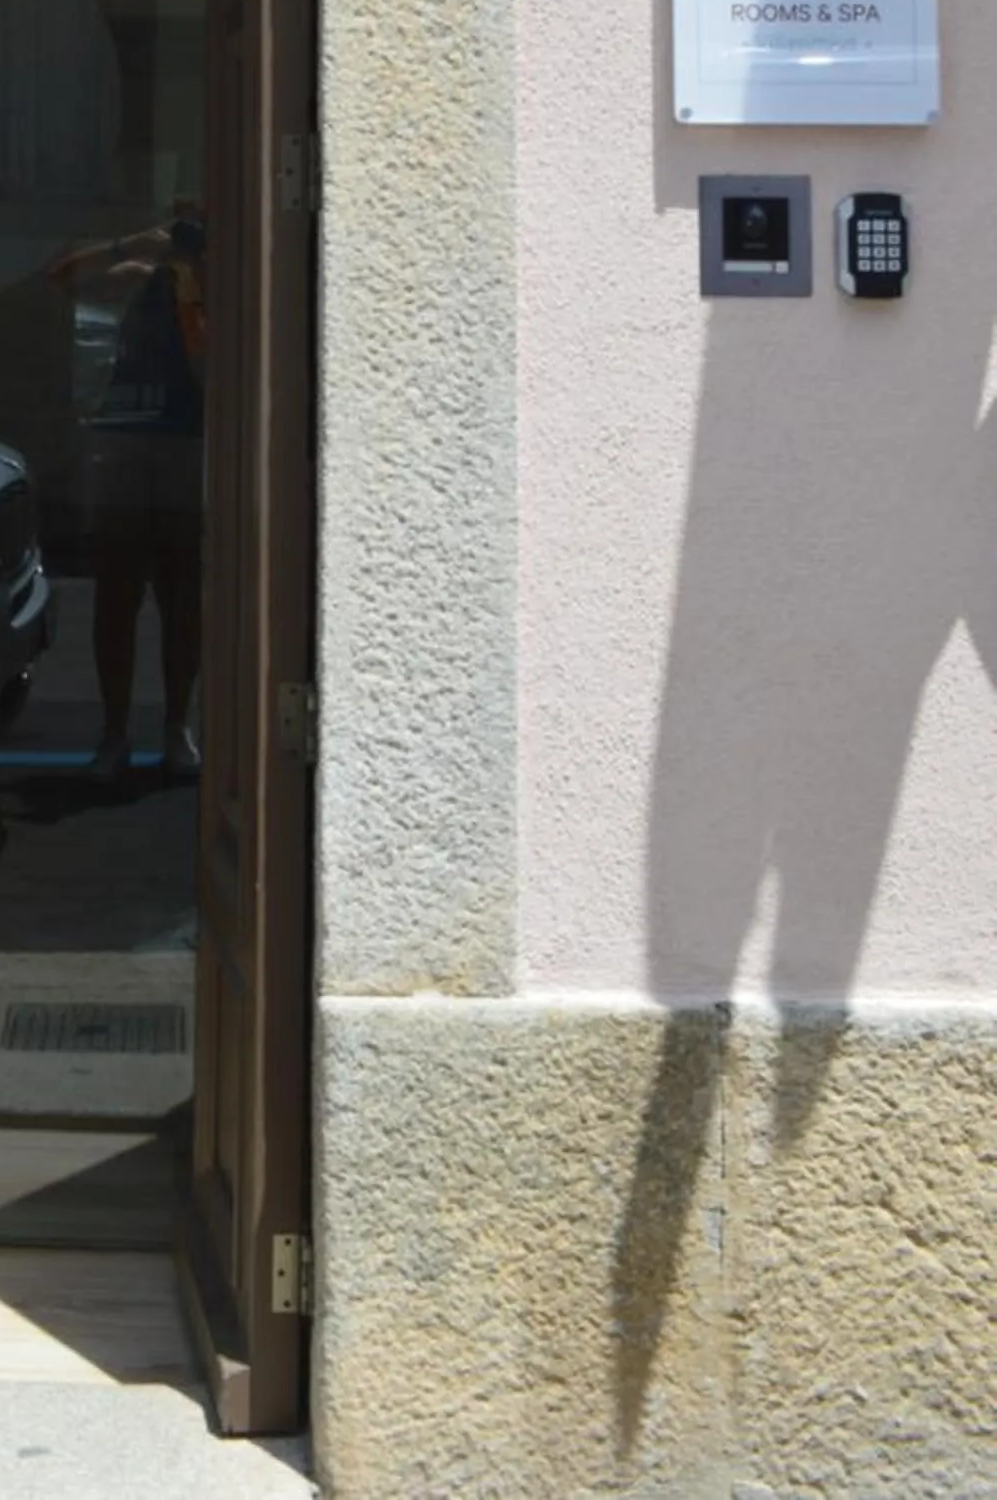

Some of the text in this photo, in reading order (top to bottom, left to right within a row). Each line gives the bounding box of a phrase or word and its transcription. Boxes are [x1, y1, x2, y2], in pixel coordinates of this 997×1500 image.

[731, 3, 881, 23] ROOMS & SPA
